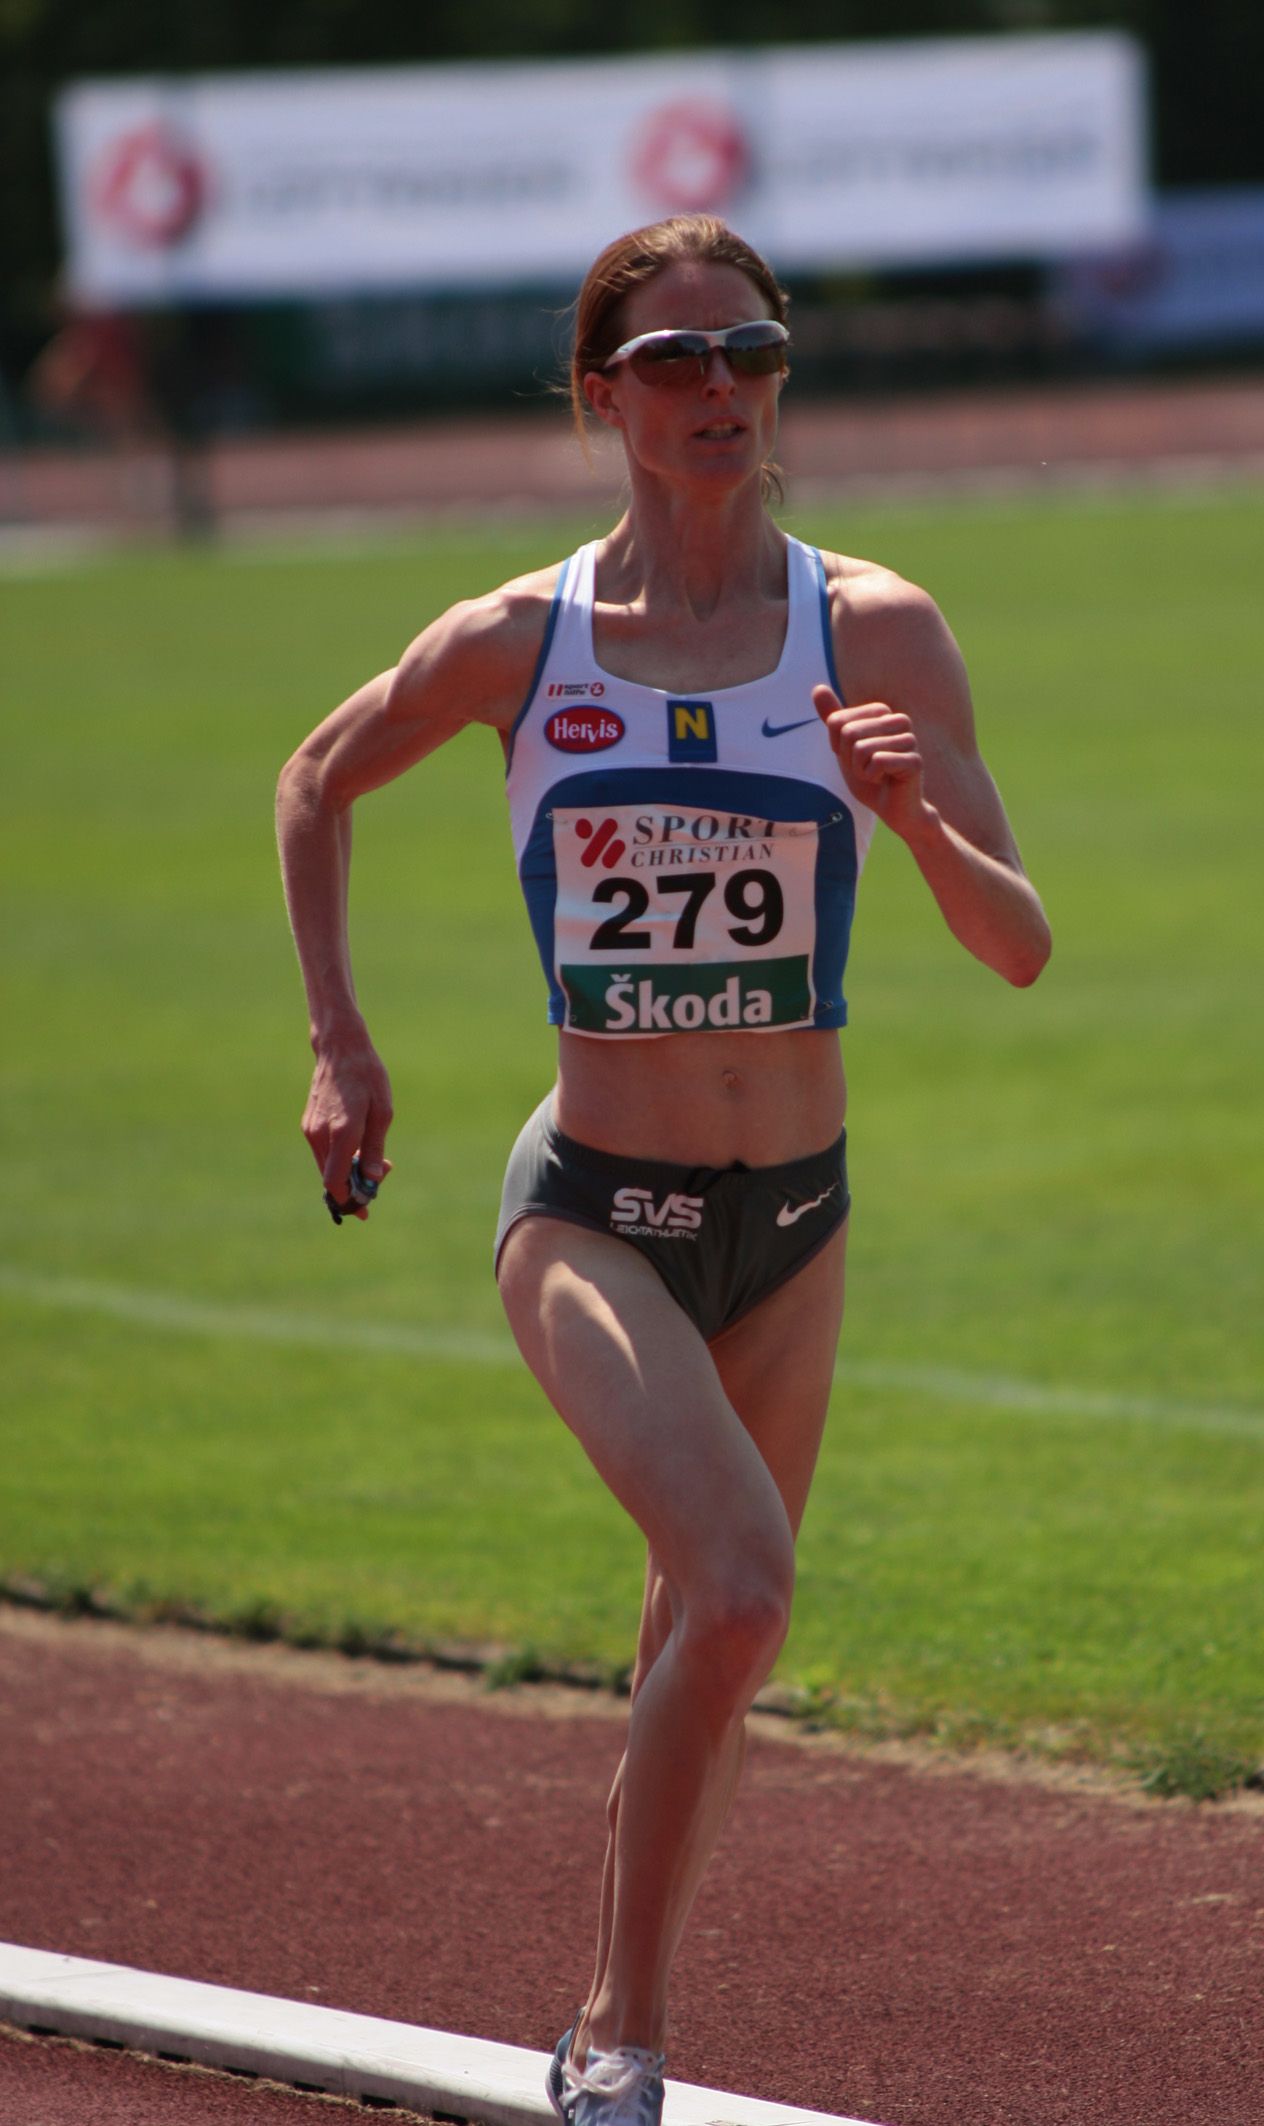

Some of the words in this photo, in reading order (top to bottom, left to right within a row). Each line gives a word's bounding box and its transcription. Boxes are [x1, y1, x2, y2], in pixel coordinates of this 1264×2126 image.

[553, 718, 619, 743] Hervis
[674, 707, 709, 740] N
[632, 814, 777, 846] SPORT
[630, 843, 775, 868] CHRISTIAN
[588, 868, 784, 951] 279
[604, 973, 773, 1030] Škoda
[610, 1187, 705, 1230] SVS
